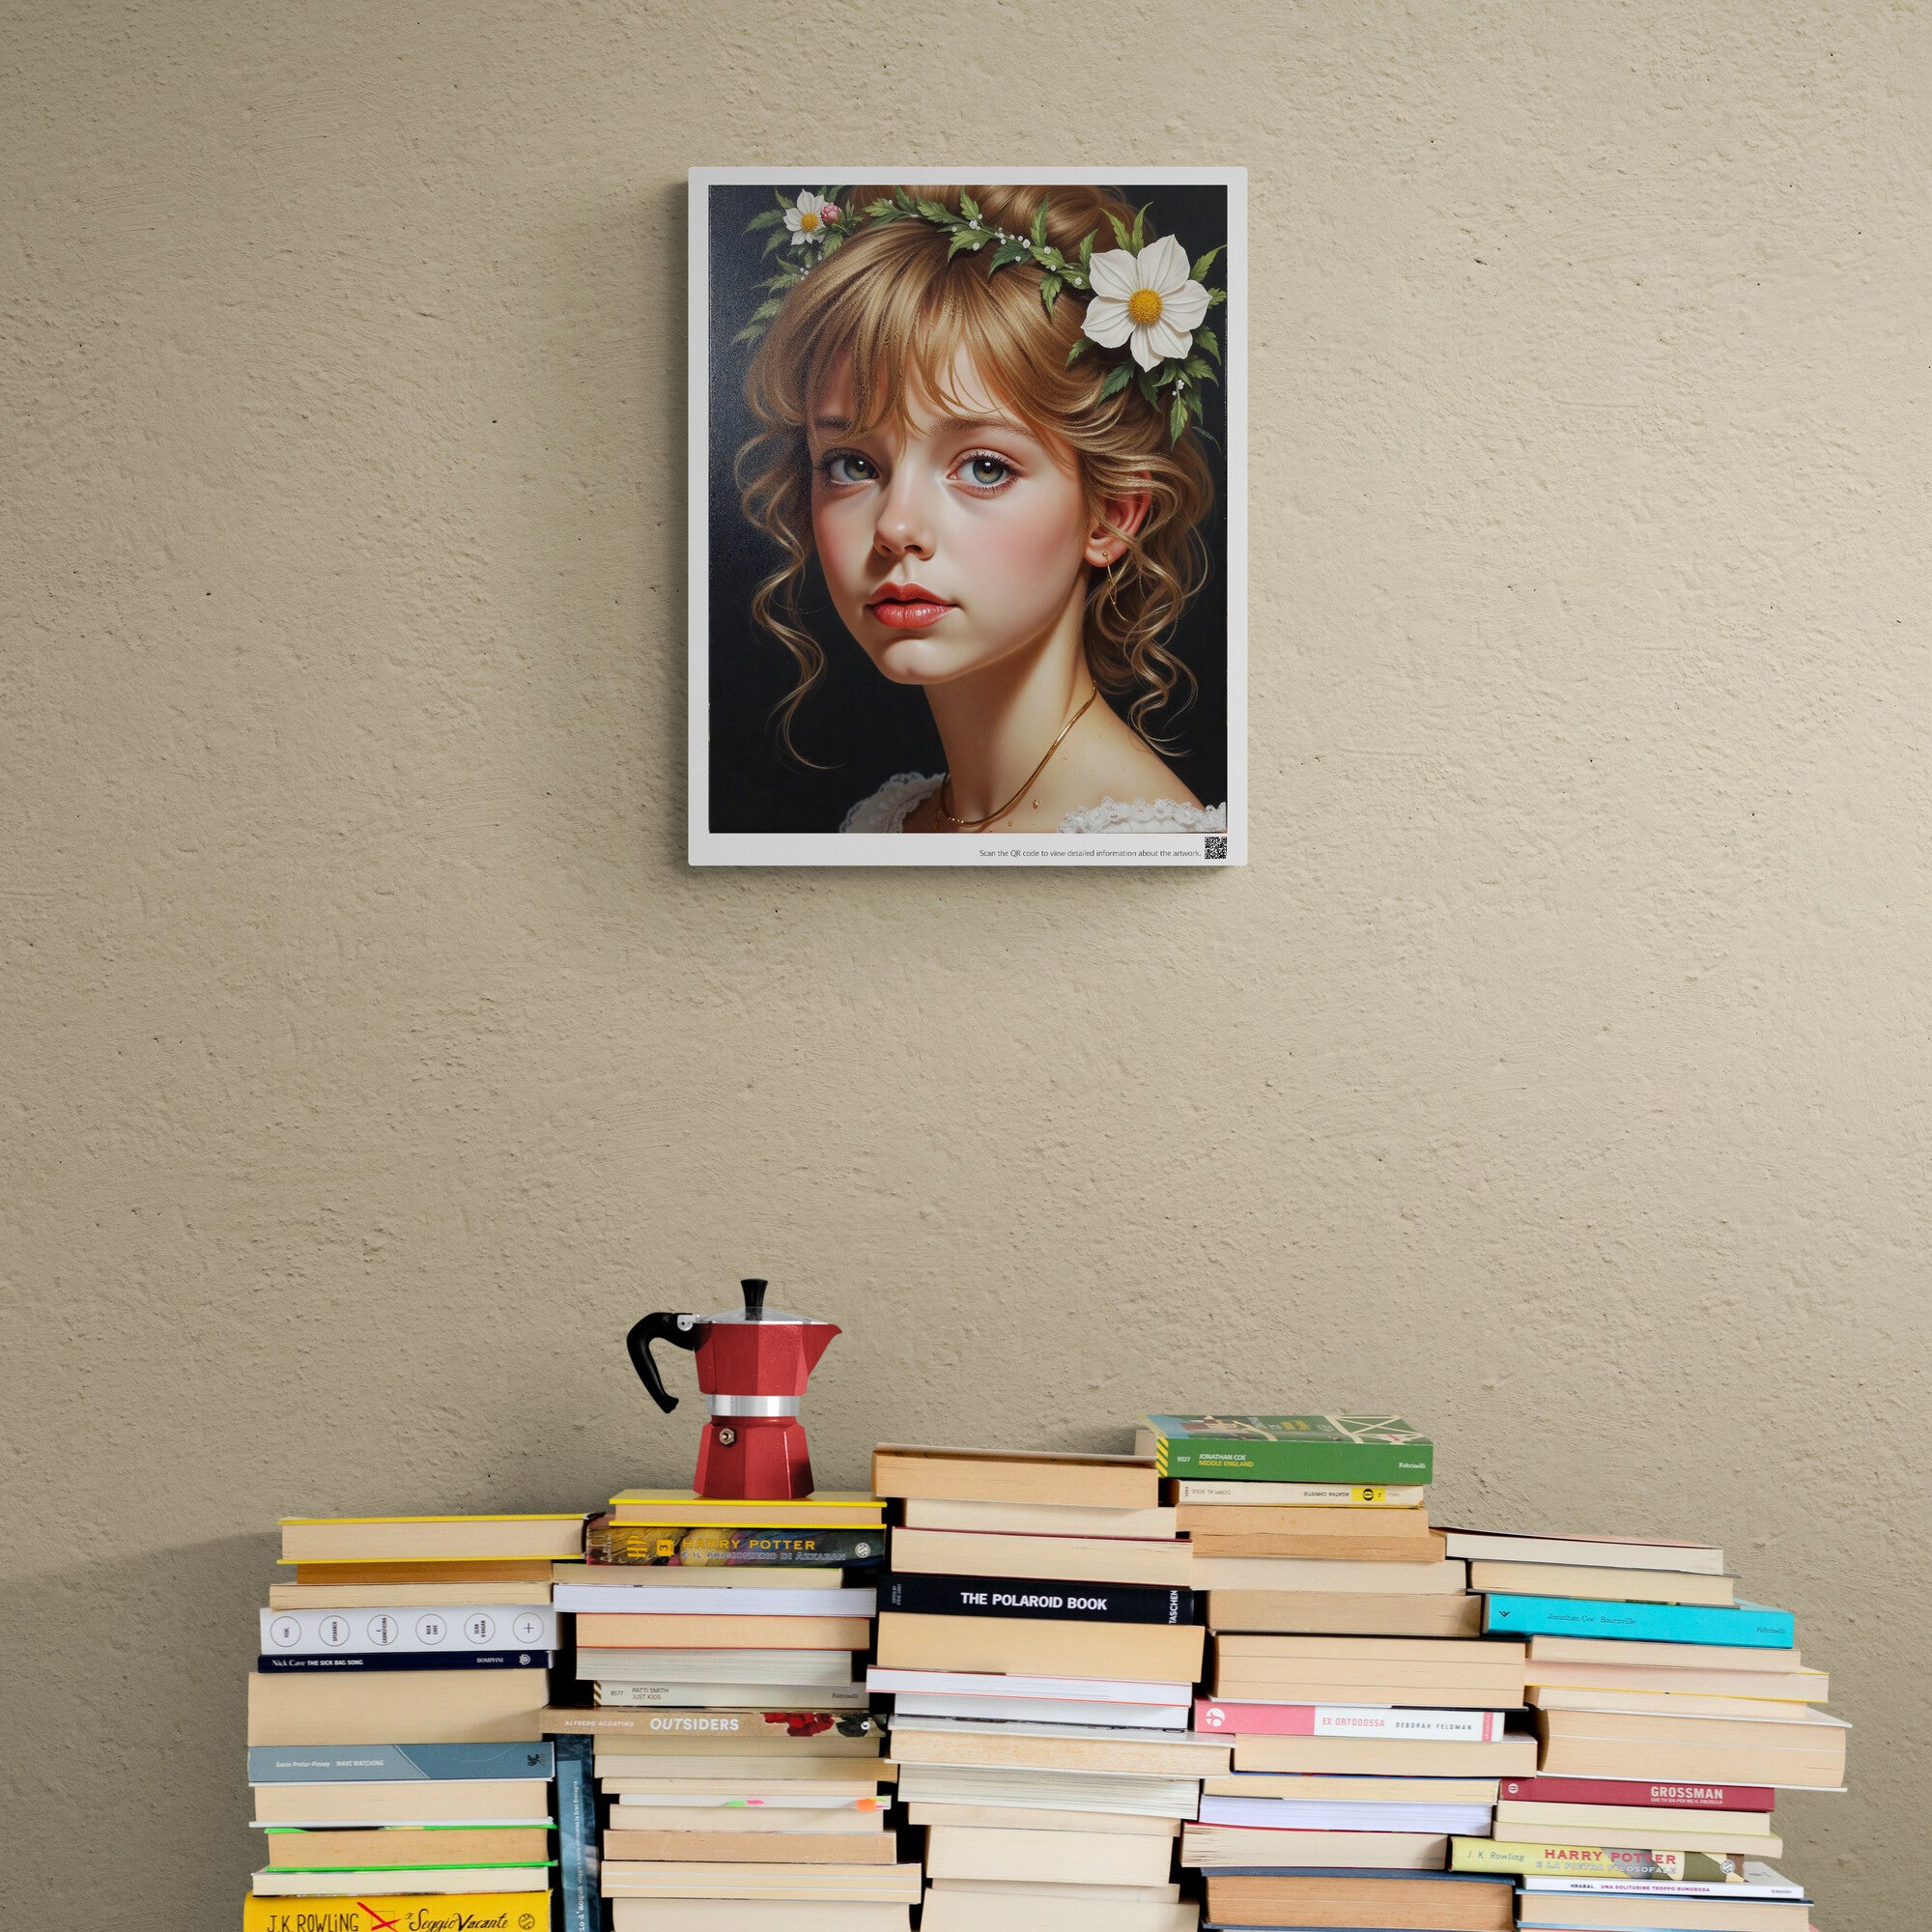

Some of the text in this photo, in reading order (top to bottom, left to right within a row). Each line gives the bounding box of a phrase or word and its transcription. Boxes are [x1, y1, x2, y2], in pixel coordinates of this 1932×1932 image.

[1010, 849, 1021, 858] QR
[682, 1539, 816, 1550] HARRY POTTER
[960, 1592, 1108, 1611] THE POLAROID BOOK
[1169, 1590, 1179, 1625] TASCHEN
[1548, 1612, 1636, 1625] Jonathan Coe Bournville
[650, 1718, 740, 1731] OUTSIDERS
[1322, 1717, 1332, 1725] EX
[1336, 1718, 1385, 1727] ORTODOSSA
[1650, 1786, 1723, 1800] GROSSMAN
[1490, 1852, 1525, 1862] Rowling
[1545, 1849, 1604, 1861] HARRY
[1610, 1852, 1677, 1865] POTTER
[1565, 1862, 1605, 1871] PIETRA
[1608, 1864, 1677, 1874] FILOSOFALE
[452, 1912, 509, 1931] Vacante
